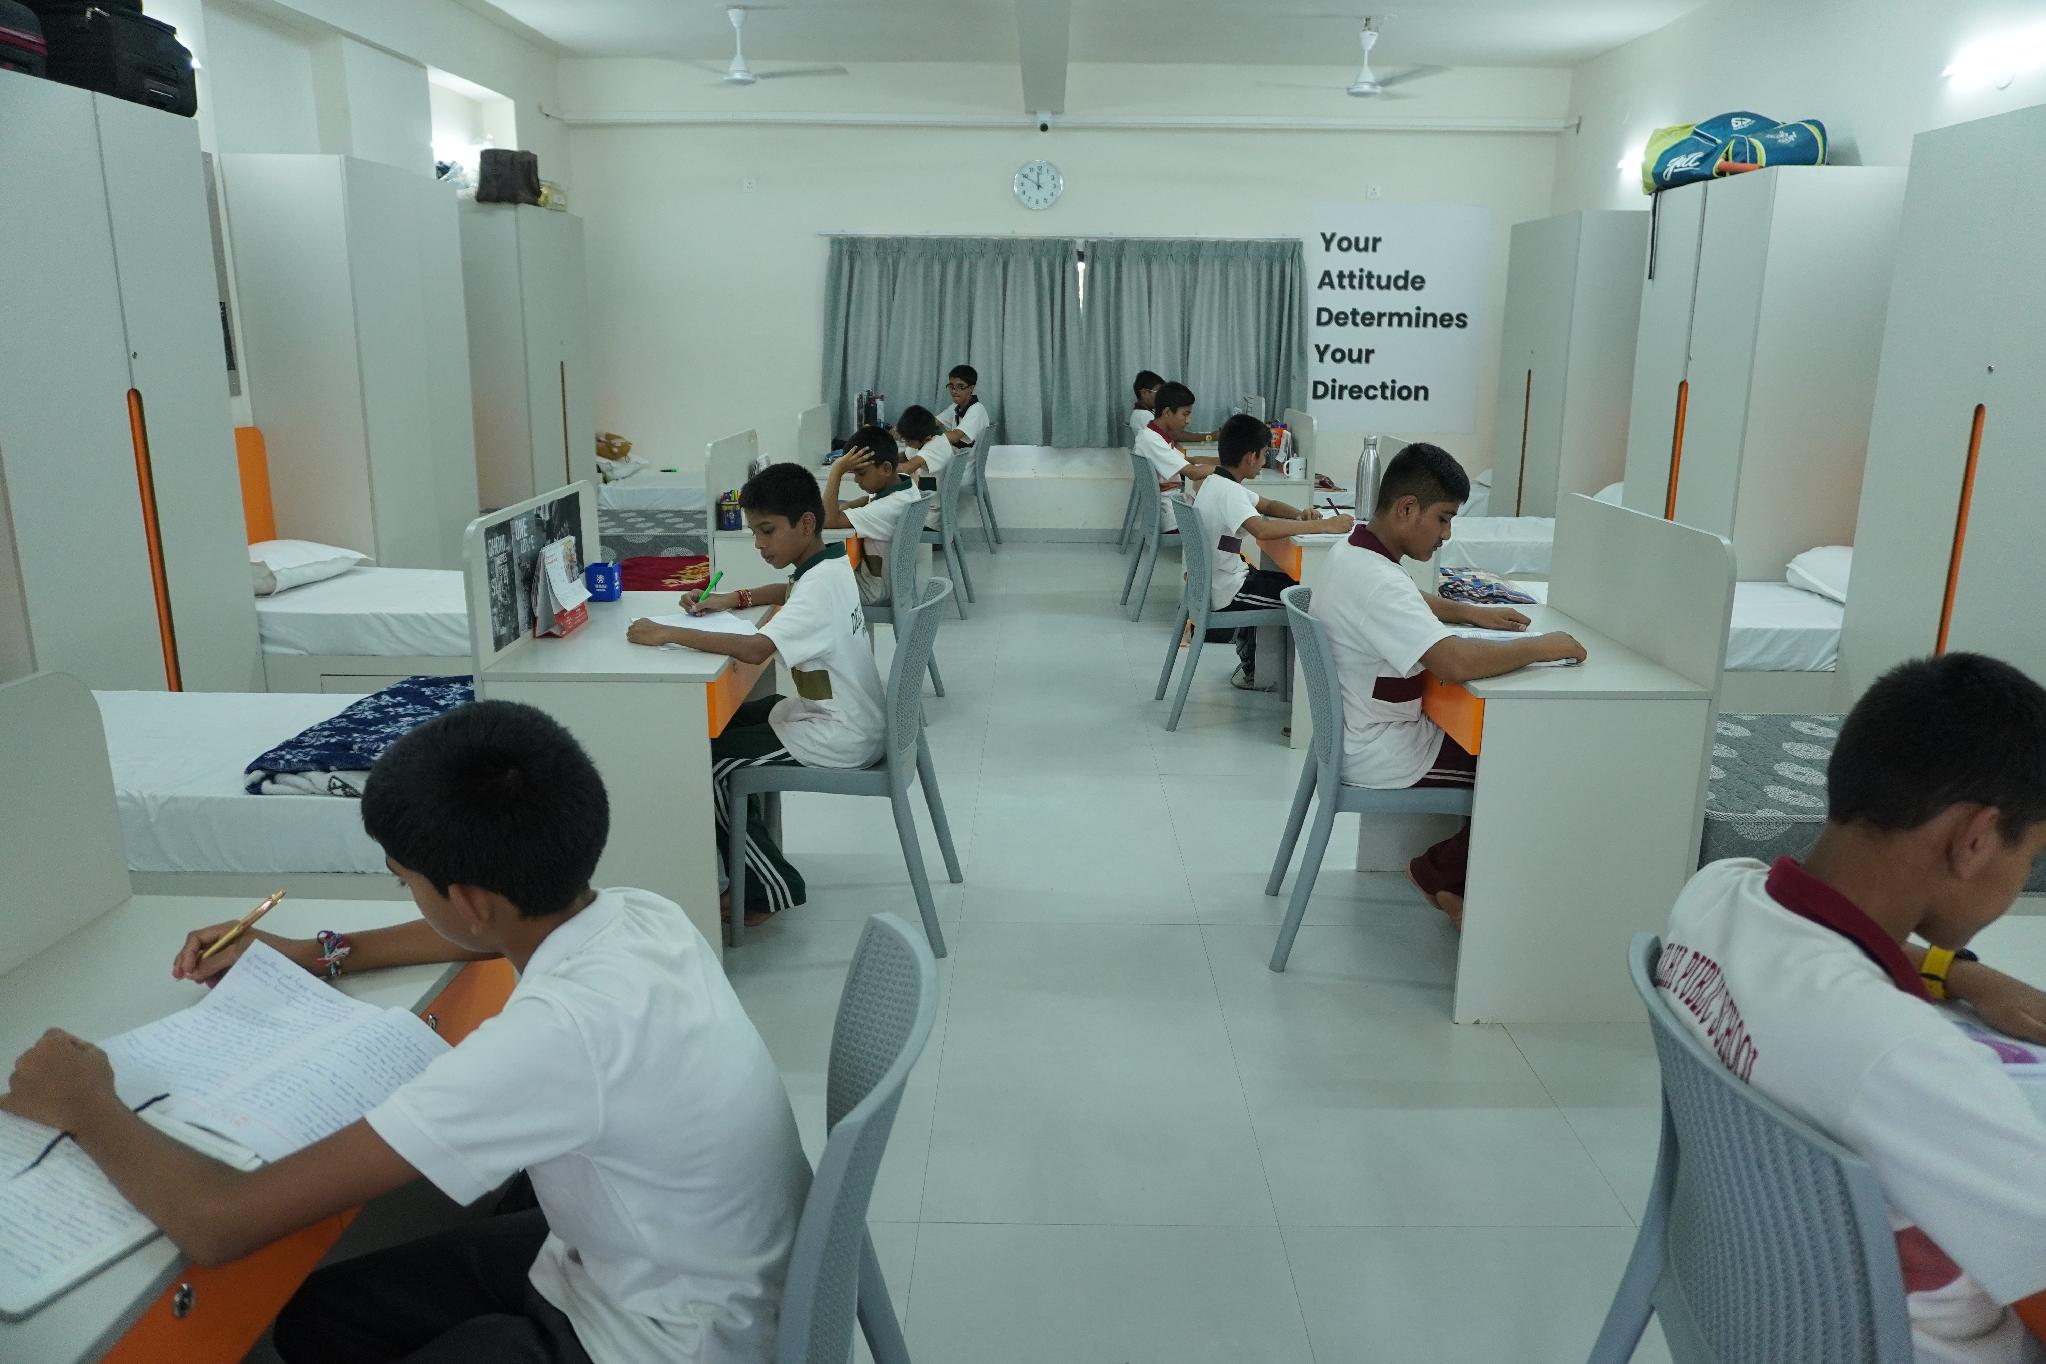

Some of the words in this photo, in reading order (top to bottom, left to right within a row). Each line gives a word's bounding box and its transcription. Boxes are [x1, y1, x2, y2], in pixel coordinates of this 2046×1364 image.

[1320, 232, 1382, 253] Your
[1317, 268, 1426, 291] Attitude
[1316, 306, 1468, 329] Determines
[1314, 344, 1376, 364] Your
[1312, 378, 1429, 401] Direction
[1673, 951, 1726, 1024] PUBLIC
